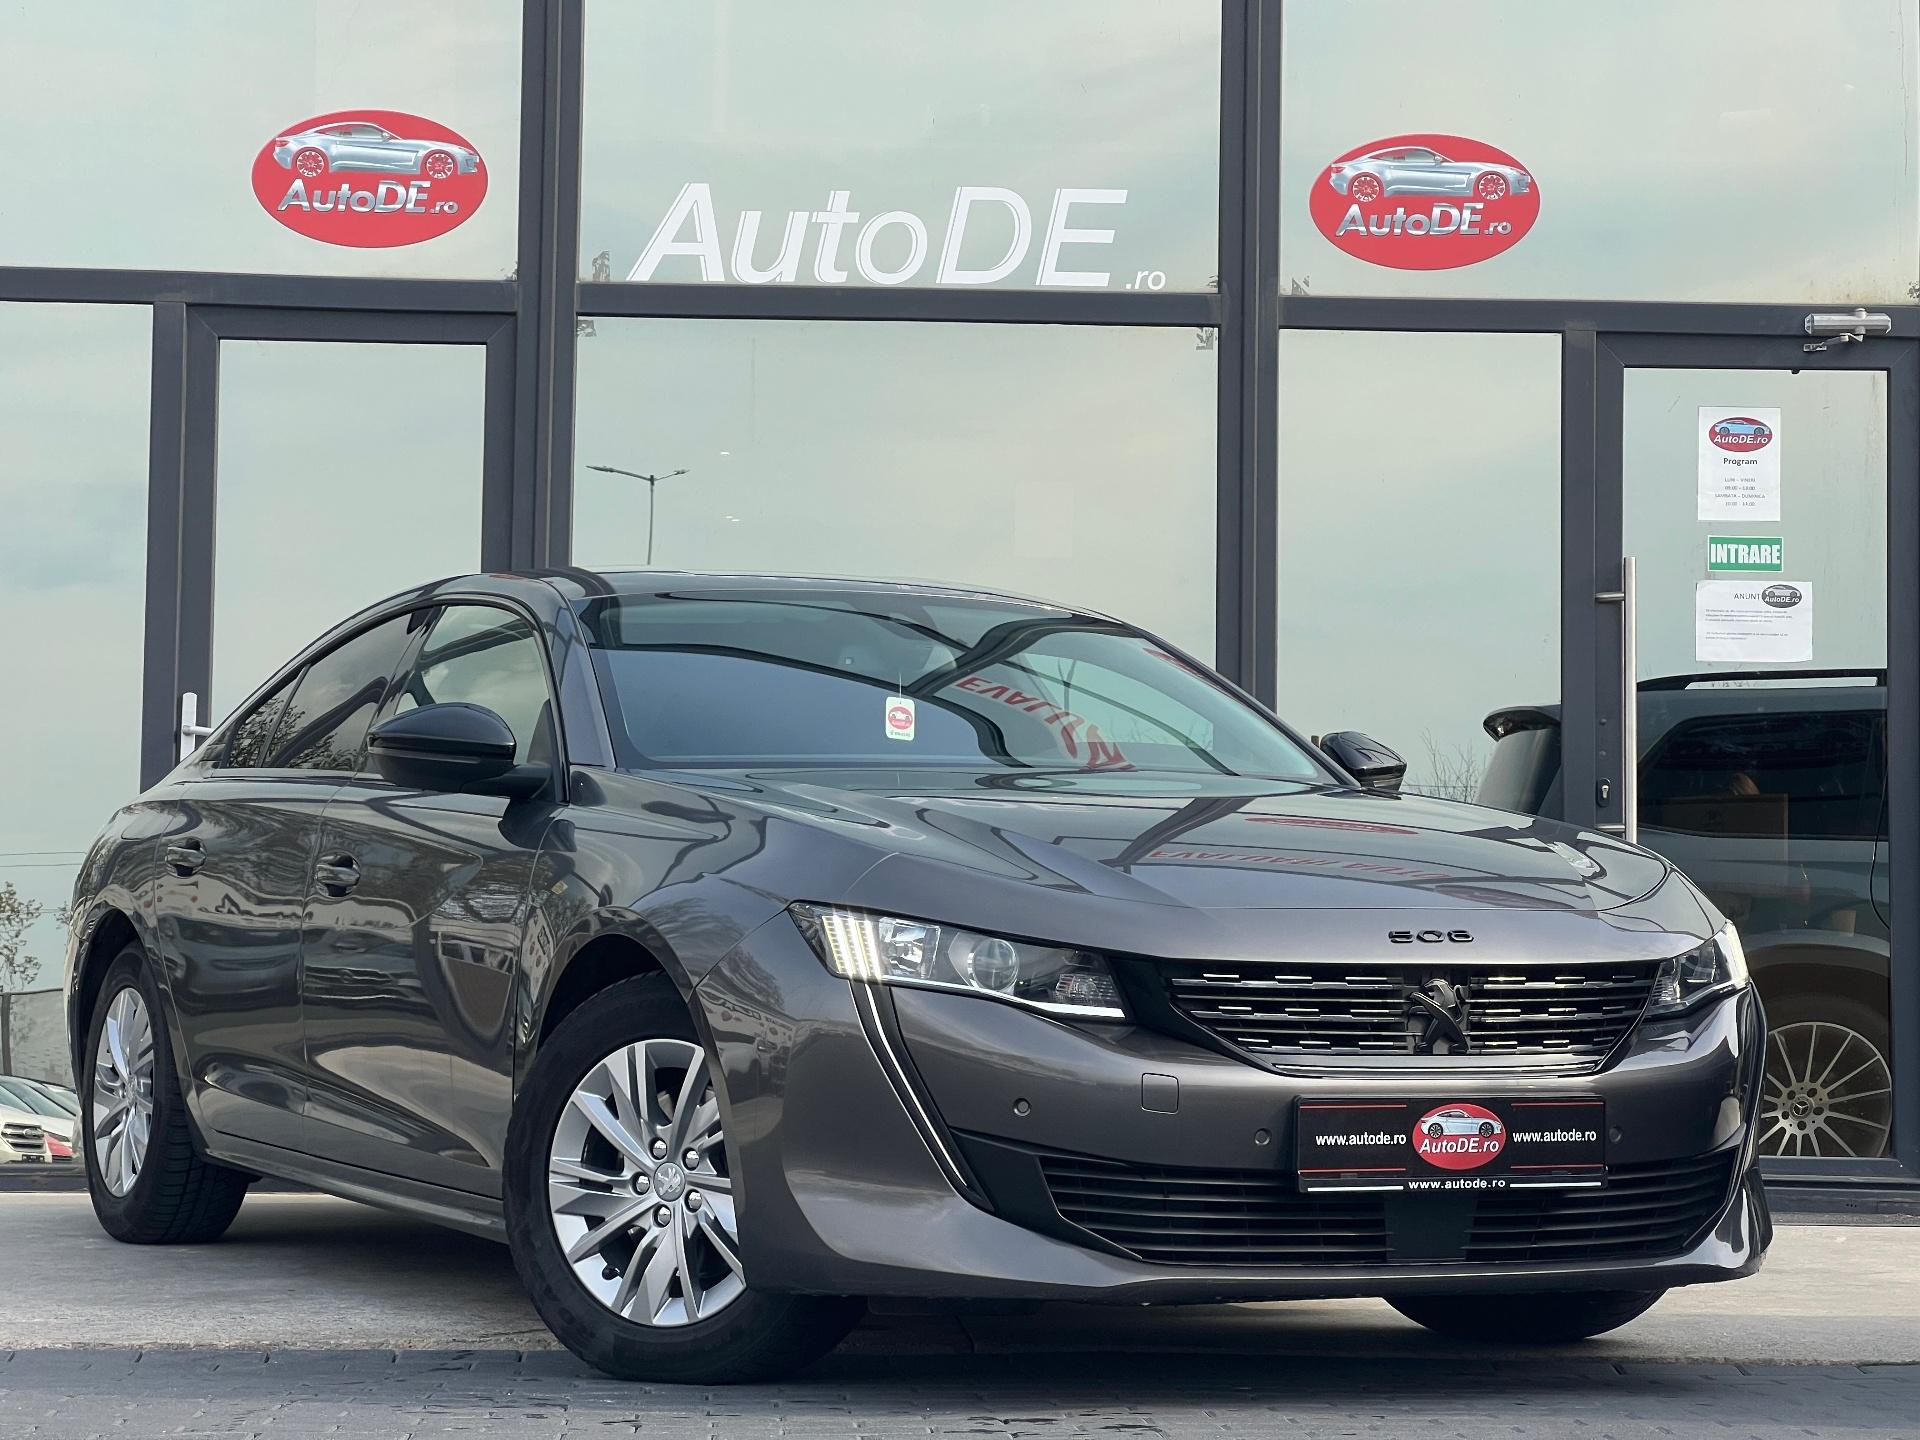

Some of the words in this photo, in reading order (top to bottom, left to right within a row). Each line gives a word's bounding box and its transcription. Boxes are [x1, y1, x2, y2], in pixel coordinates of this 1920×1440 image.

[1713, 433, 1769, 445] AutoDE.ro
[1723, 457, 1758, 467] Program
[1710, 543, 1781, 565] INTRARE
[1388, 930, 1474, 943] 508
[1315, 1131, 1407, 1146] www.autode.ro
[1512, 1128, 1597, 1143] www.autode.ro
[1419, 1137, 1500, 1154] AutoDE.ro
[1408, 1178, 1506, 1190] www.autode.ro
